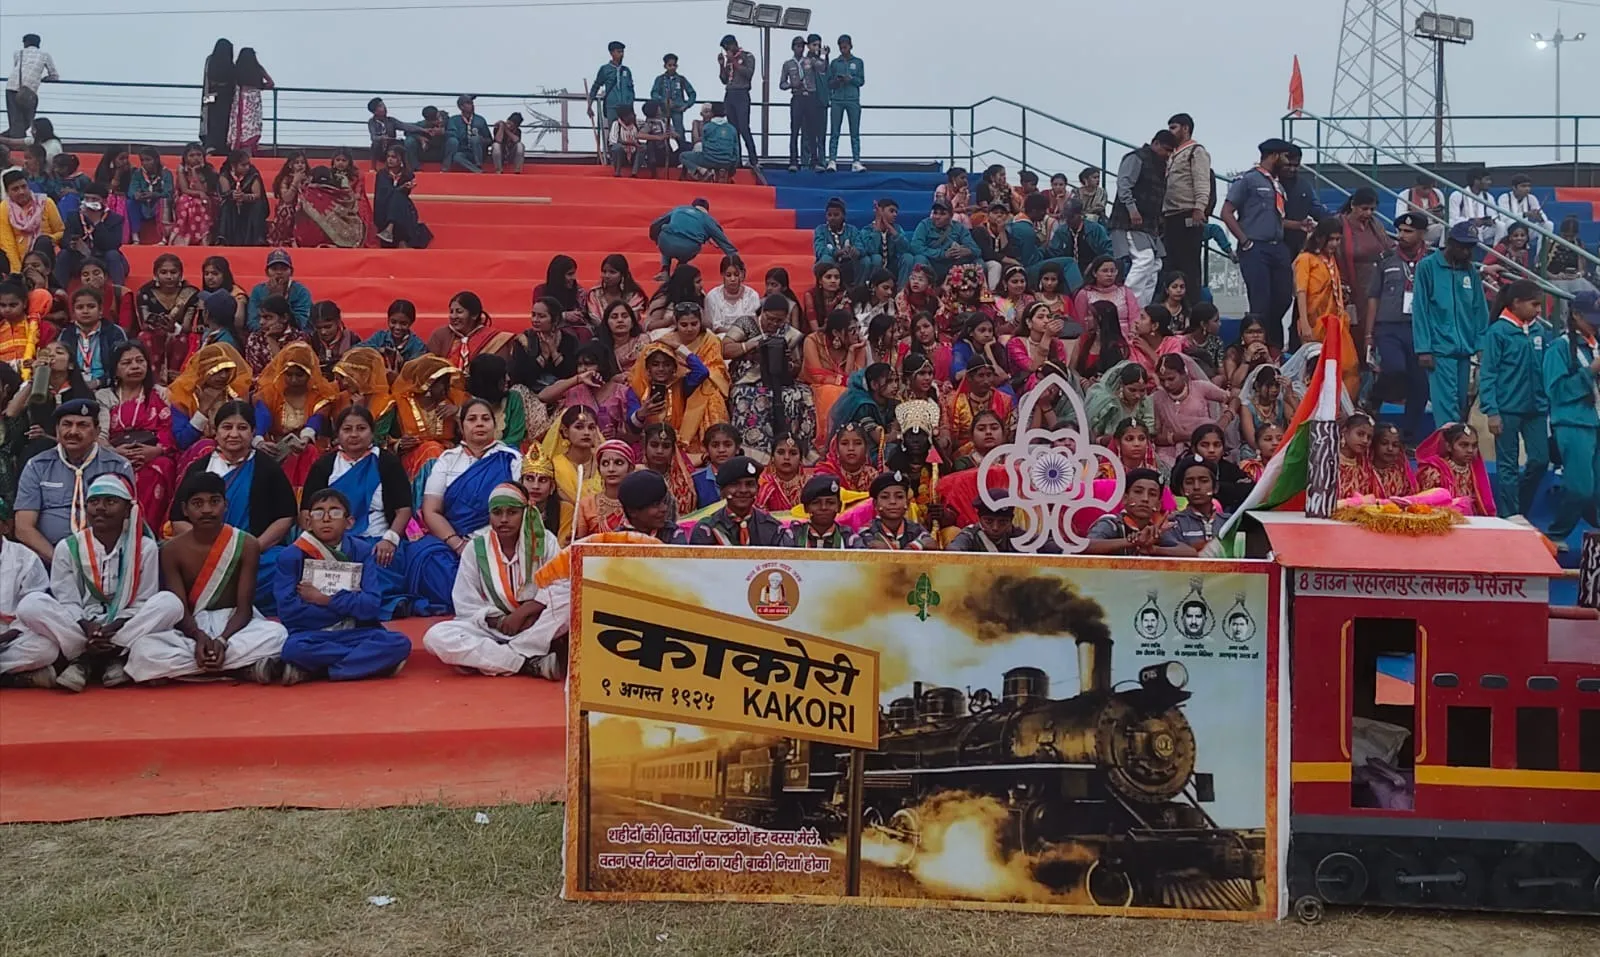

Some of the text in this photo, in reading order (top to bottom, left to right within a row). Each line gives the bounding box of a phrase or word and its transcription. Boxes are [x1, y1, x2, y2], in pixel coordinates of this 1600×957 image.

[1299, 572, 1309, 590] 8
[1312, 573, 1349, 591] डाउन
[592, 610, 860, 696] काकोरी
[619, 682, 664, 702] अगस्त
[671, 687, 715, 710] १९२५
[744, 687, 855, 734] KAKORI
[608, 824, 643, 842] शहीदों
[644, 825, 659, 842] की
[662, 825, 701, 843] चिताओं
[703, 831, 717, 843] पर
[719, 827, 750, 844] लगेंगे
[753, 832, 768, 845] हर
[599, 855, 625, 868] वतन
[628, 855, 644, 868] पर
[645, 851, 674, 868] मिटने
[677, 853, 703, 869] वालों
[704, 857, 720, 869] का
[722, 853, 743, 870] यही
[775, 853, 802, 870] निशां
[804, 855, 830, 872] होगा
